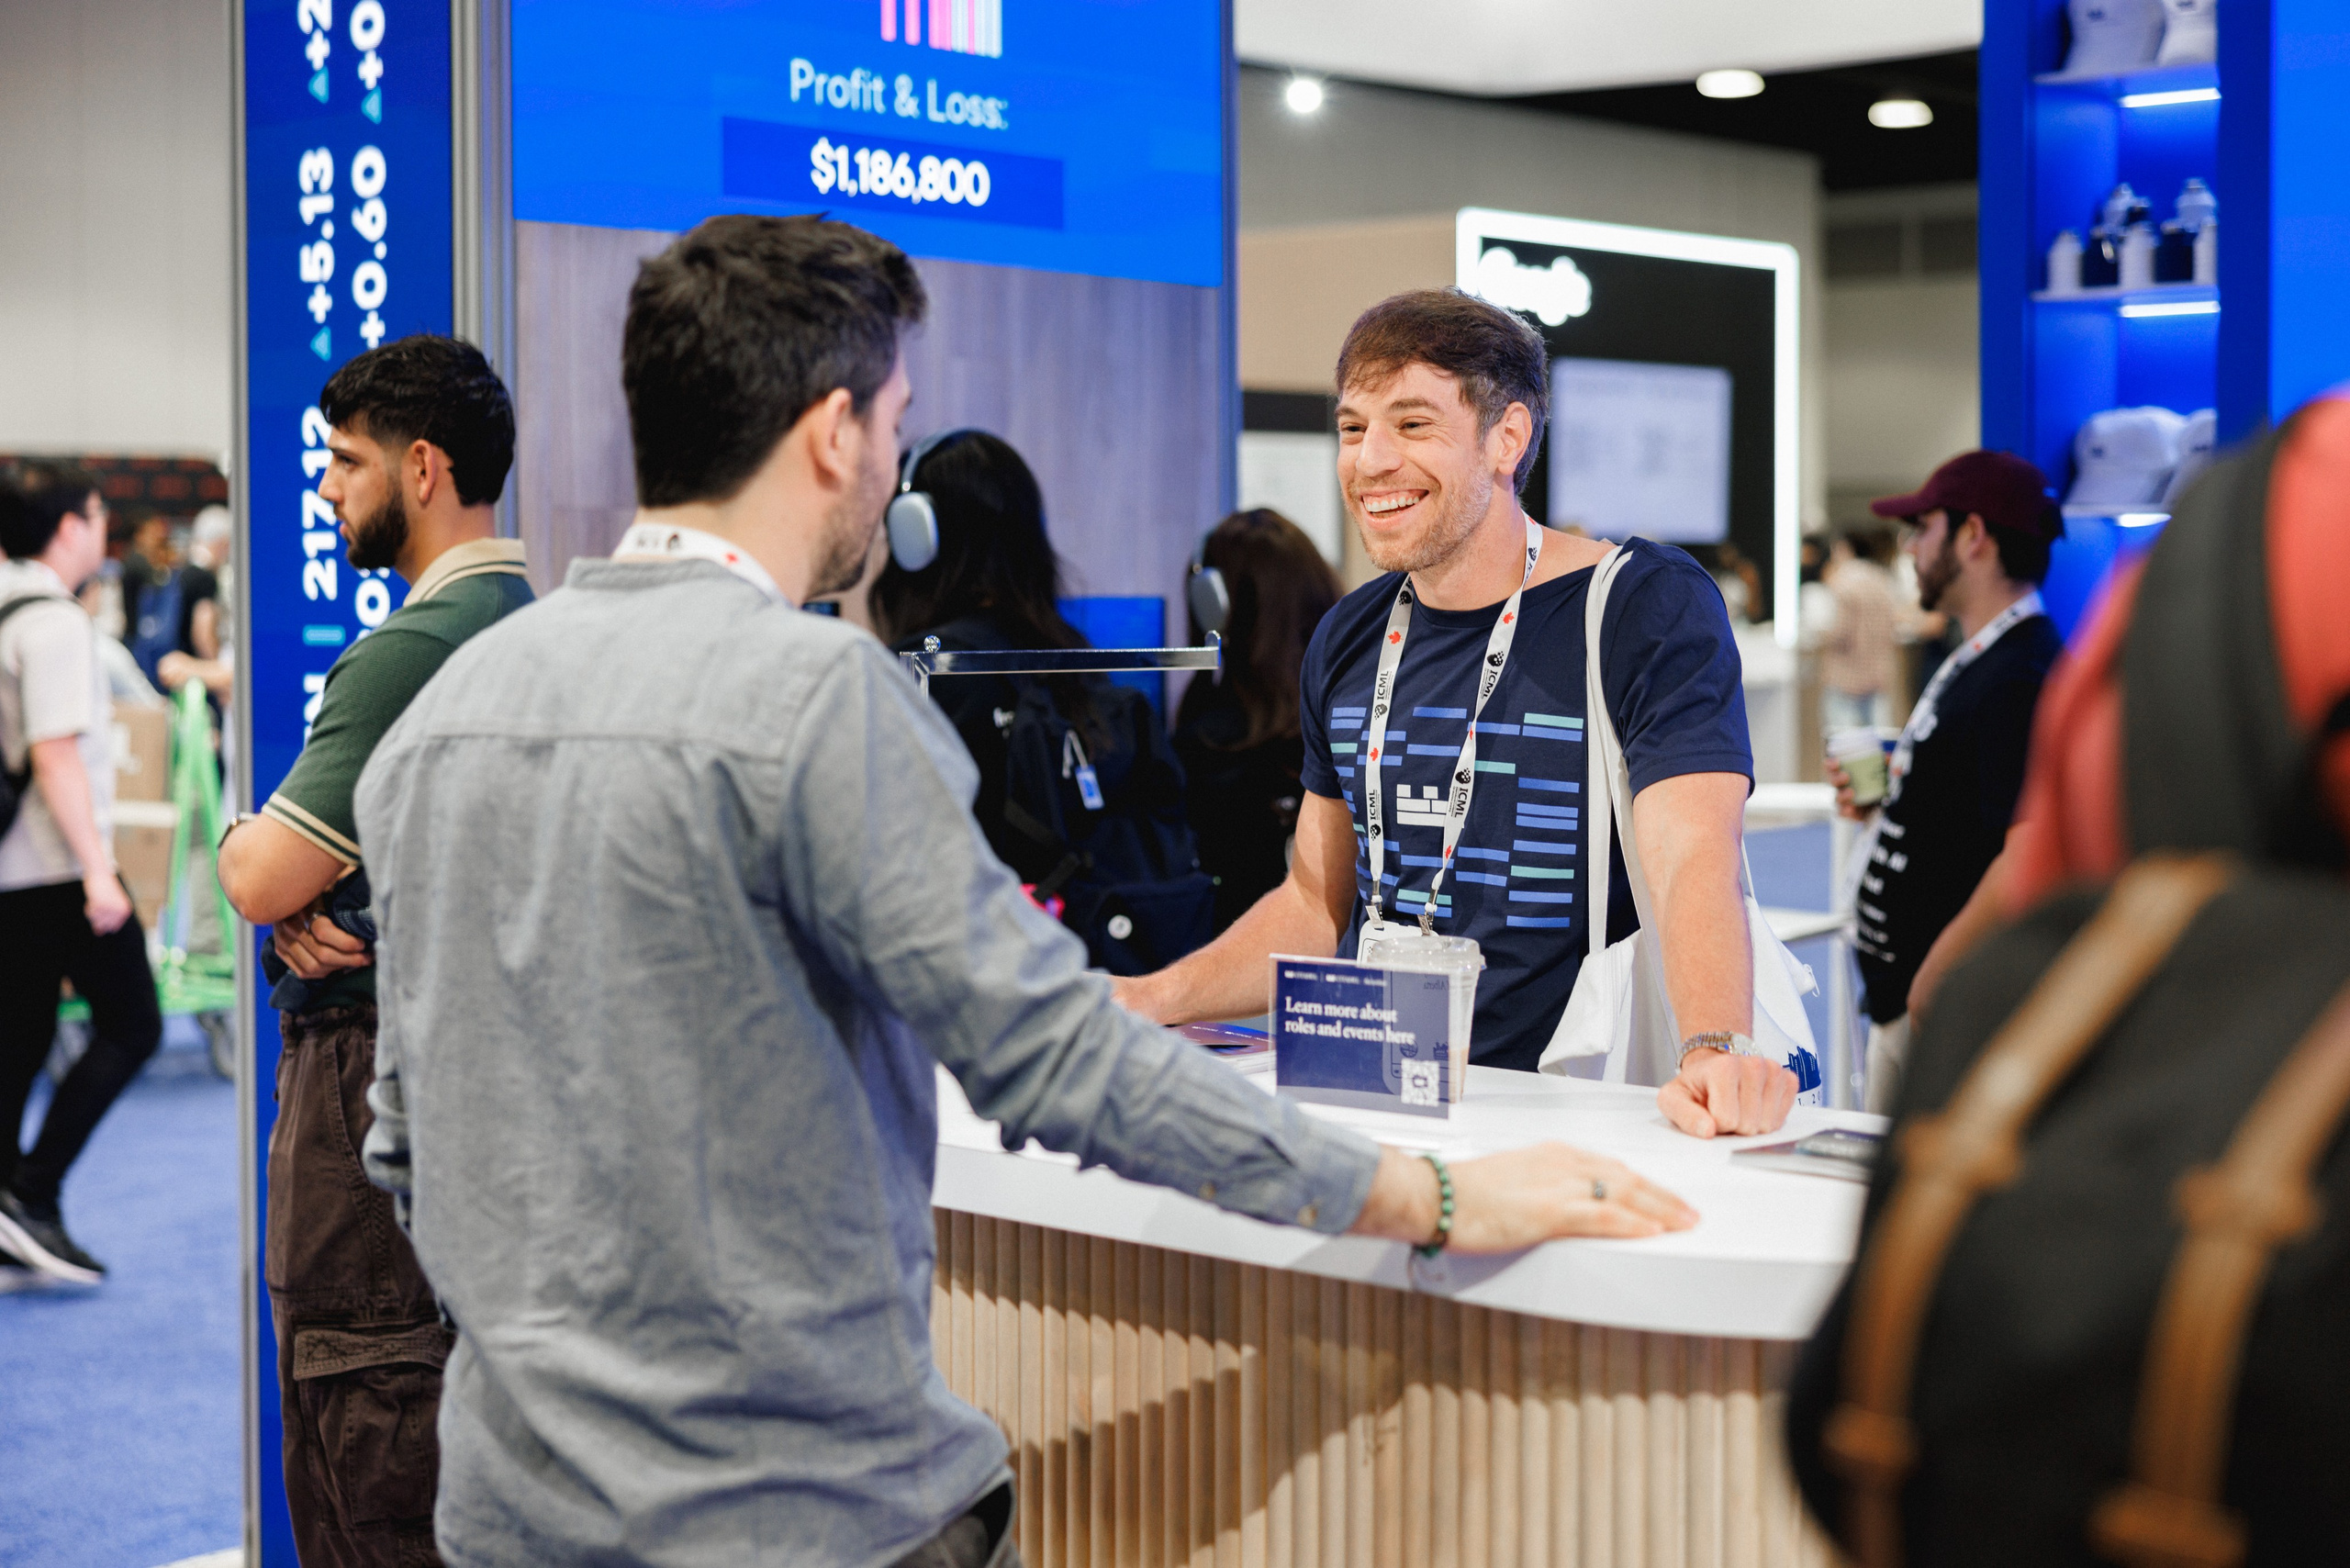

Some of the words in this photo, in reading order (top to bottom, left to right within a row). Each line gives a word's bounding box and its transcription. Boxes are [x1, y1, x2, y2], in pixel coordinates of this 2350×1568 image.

[789, 57, 887, 114] Profit
[893, 73, 921, 119] &
[926, 78, 1009, 129] Loss:
[810, 136, 991, 207] $1,186,800
[298, 146, 334, 324] +5.13
[351, 144, 387, 350] +0.60
[1377, 670, 1389, 700] ICML
[1483, 670, 1497, 698] ICML
[1454, 787, 1469, 818] ICML
[1285, 996, 1323, 1016] Learn
[1324, 1003, 1359, 1019] more
[1360, 1002, 1398, 1023] about
[1285, 1016, 1316, 1035] roles
[1317, 1020, 1341, 1037] and
[1343, 1025, 1384, 1042] events
[1385, 1024, 1416, 1046] here
